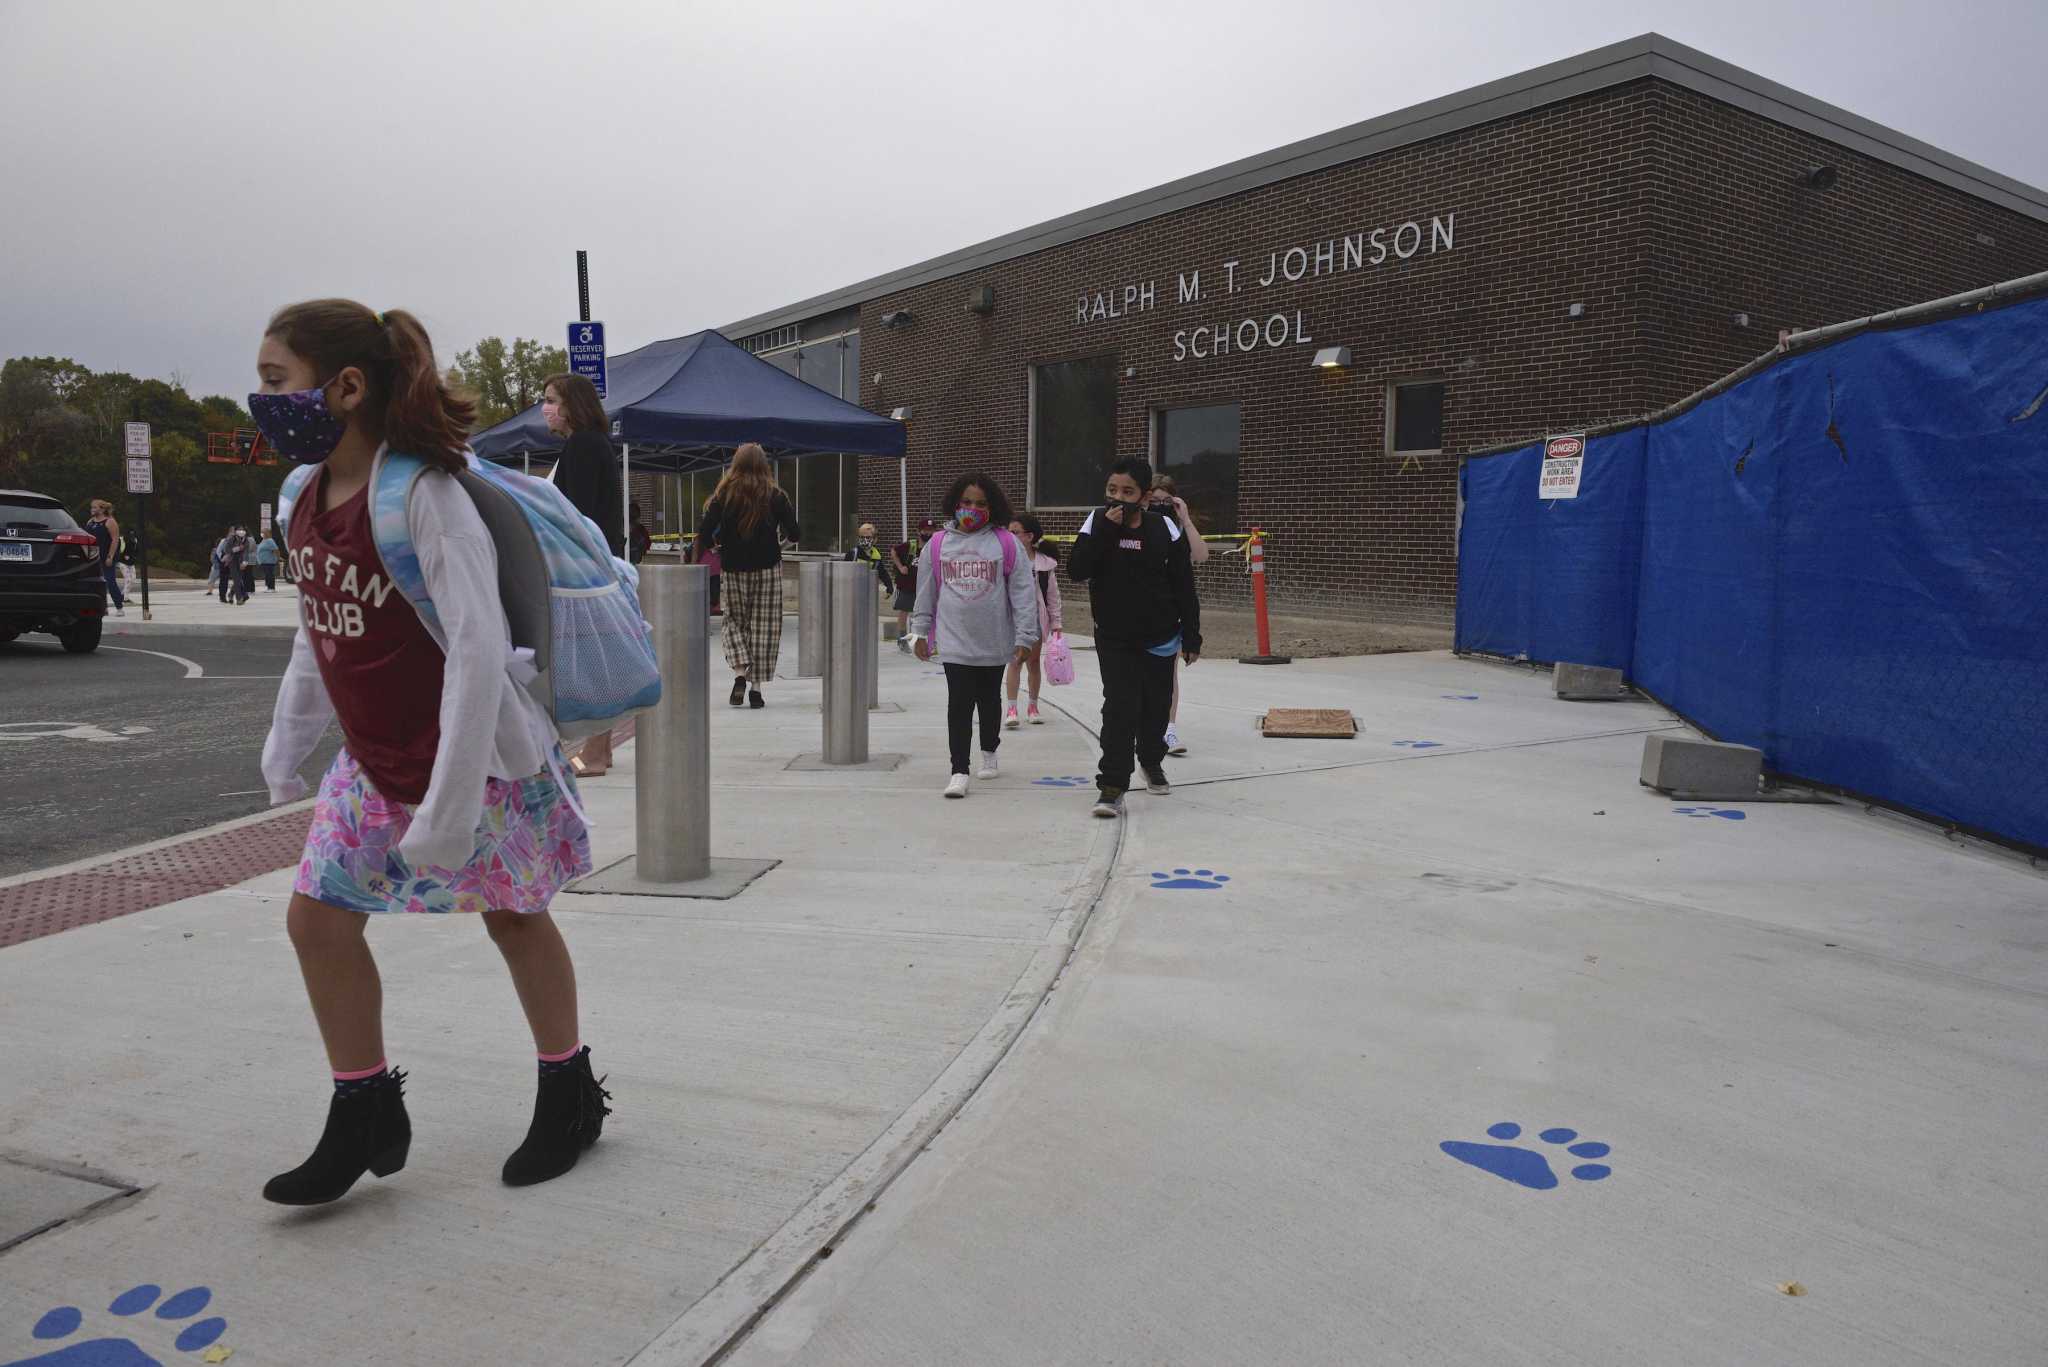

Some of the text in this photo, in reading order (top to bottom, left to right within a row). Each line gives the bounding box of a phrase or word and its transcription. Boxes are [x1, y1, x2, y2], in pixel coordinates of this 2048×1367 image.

[1077, 280, 1155, 325] RALPH
[1259, 212, 1456, 287] JOHNSON
[570, 344, 603, 353] RESERVED
[1173, 310, 1312, 362] SCHOOL
[1545, 460, 1579, 468] CONSTRUCTION
[1549, 442, 1578, 454] DANGER
[324, 553, 396, 608] FAN
[941, 559, 997, 584] UNICORN
[303, 594, 365, 637] CLUB
